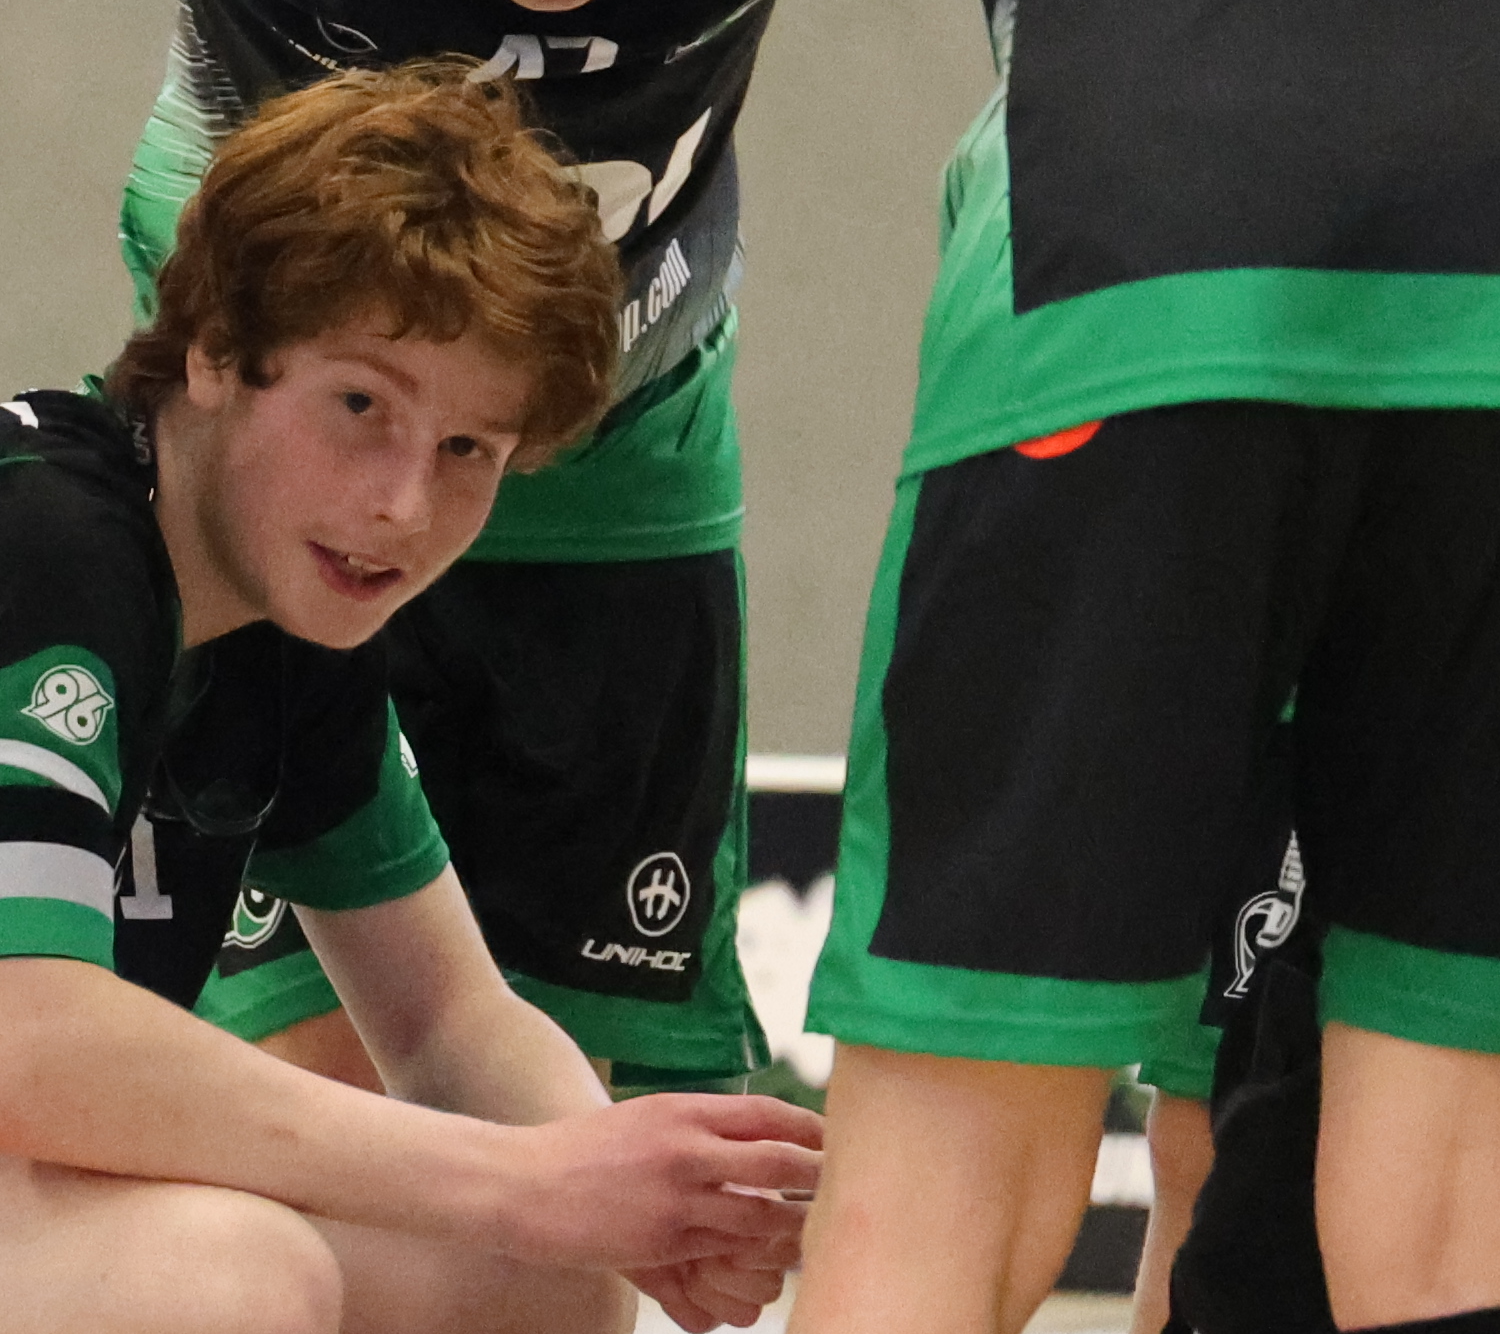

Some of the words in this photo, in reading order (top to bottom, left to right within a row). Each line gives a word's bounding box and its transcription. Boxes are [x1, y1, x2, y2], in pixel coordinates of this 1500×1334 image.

[617, 237, 692, 353] p.com
[20, 663, 115, 746] 96
[581, 938, 692, 972] UNIHOC
